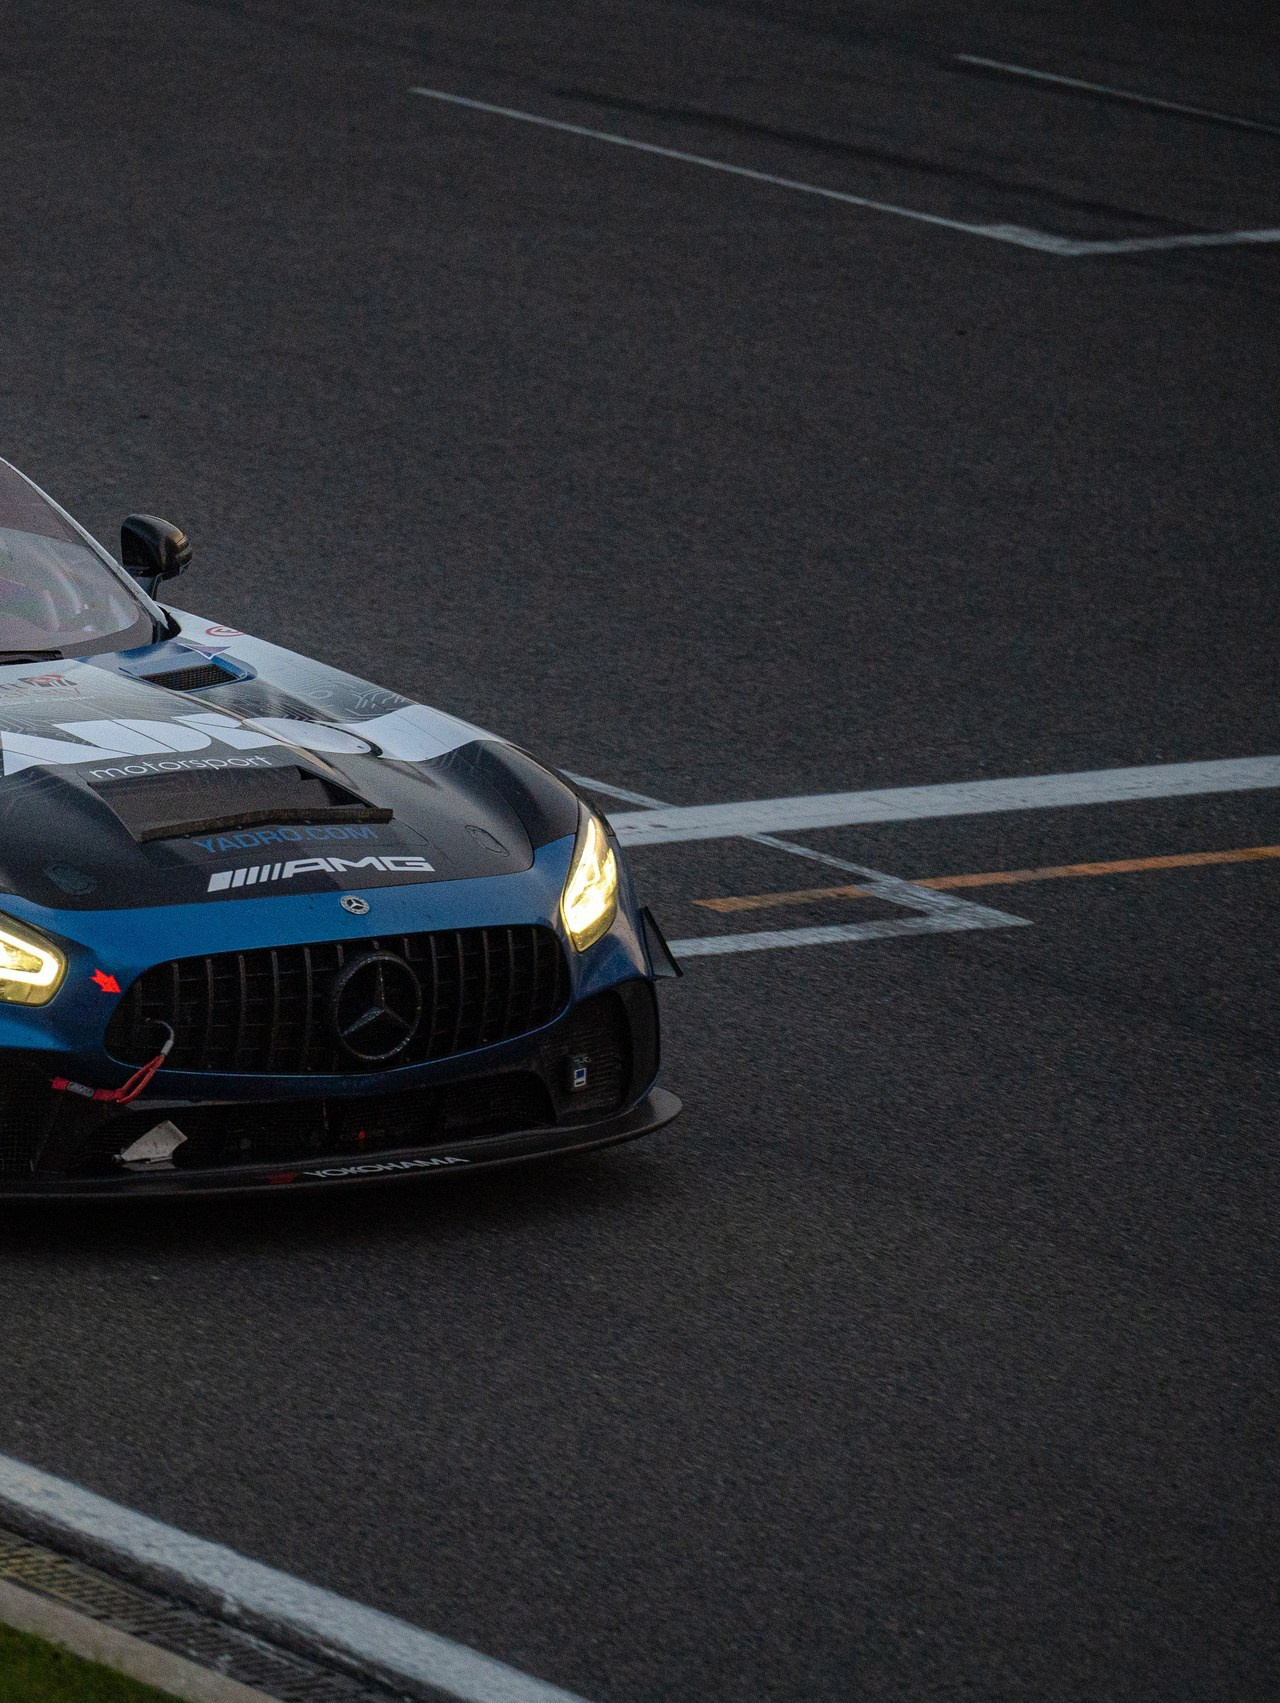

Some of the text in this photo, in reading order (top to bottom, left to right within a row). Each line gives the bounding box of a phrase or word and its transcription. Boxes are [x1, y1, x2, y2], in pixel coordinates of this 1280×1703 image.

[89, 753, 272, 780] motorsport
[193, 825, 380, 854] YADRO.COM
[302, 1156, 471, 1178] YOKOHAMA
